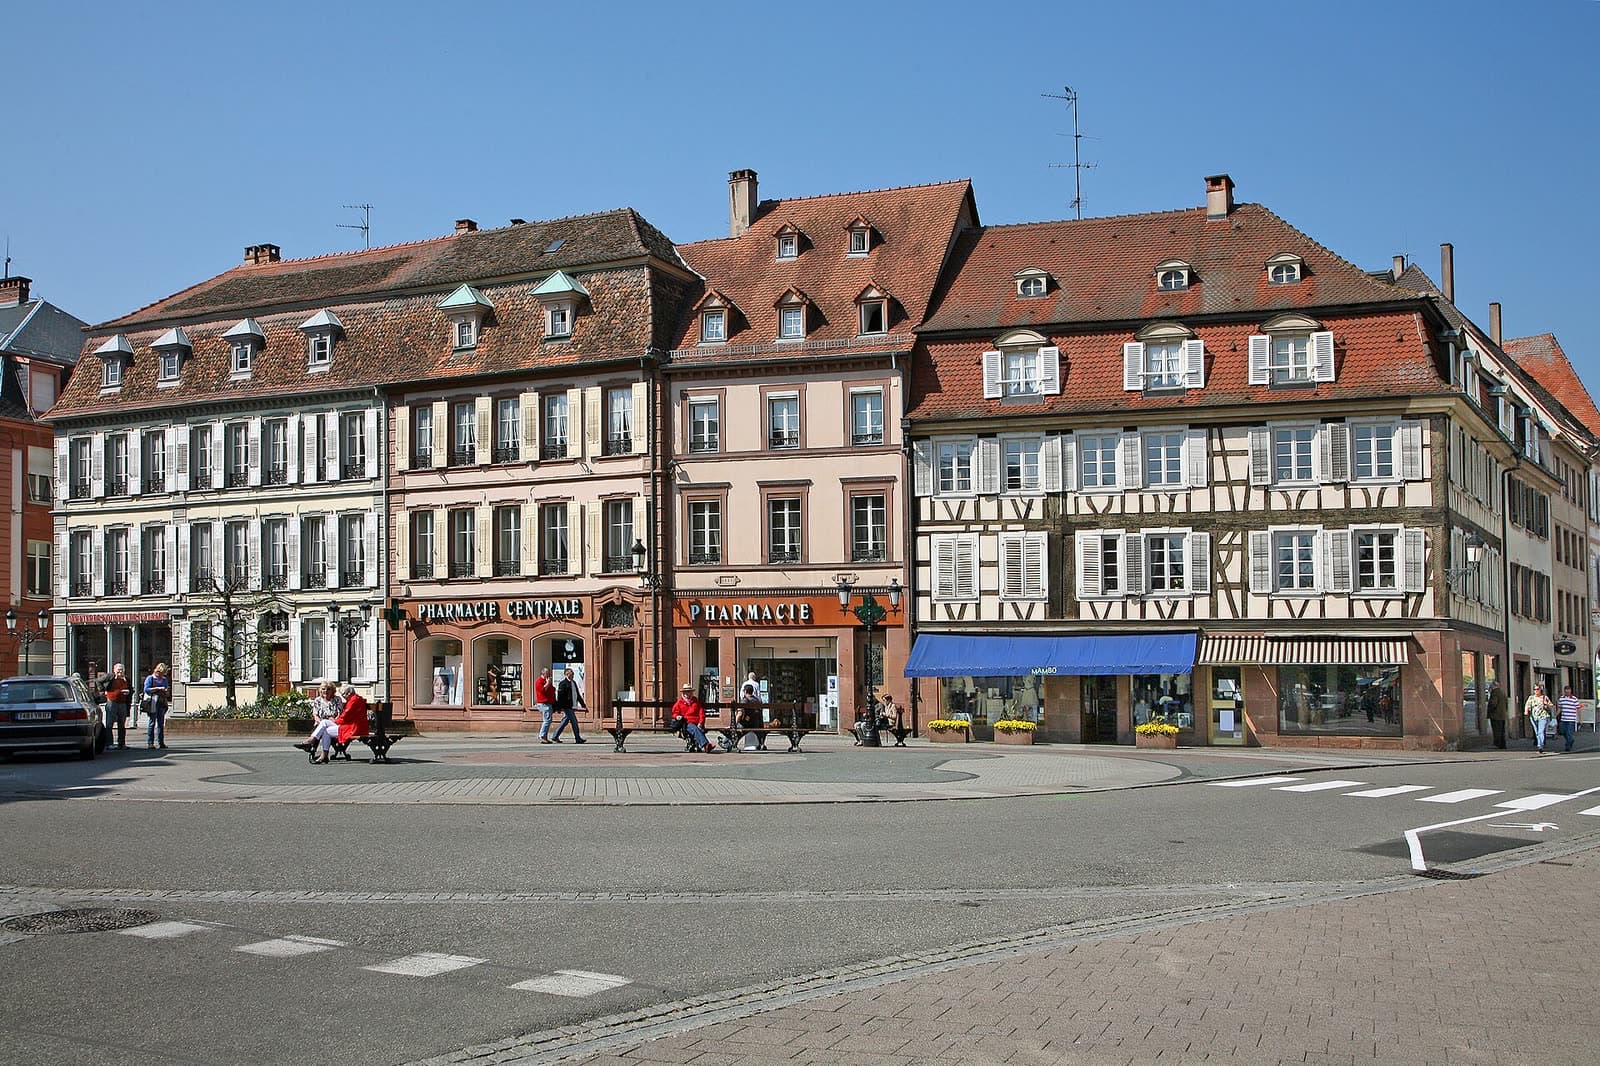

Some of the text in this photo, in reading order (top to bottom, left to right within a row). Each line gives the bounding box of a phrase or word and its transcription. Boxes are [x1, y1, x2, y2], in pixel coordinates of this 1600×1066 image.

[418, 599, 580, 619] PHARMACIE CENTRALE
[690, 603, 810, 621] PHARMACIE
